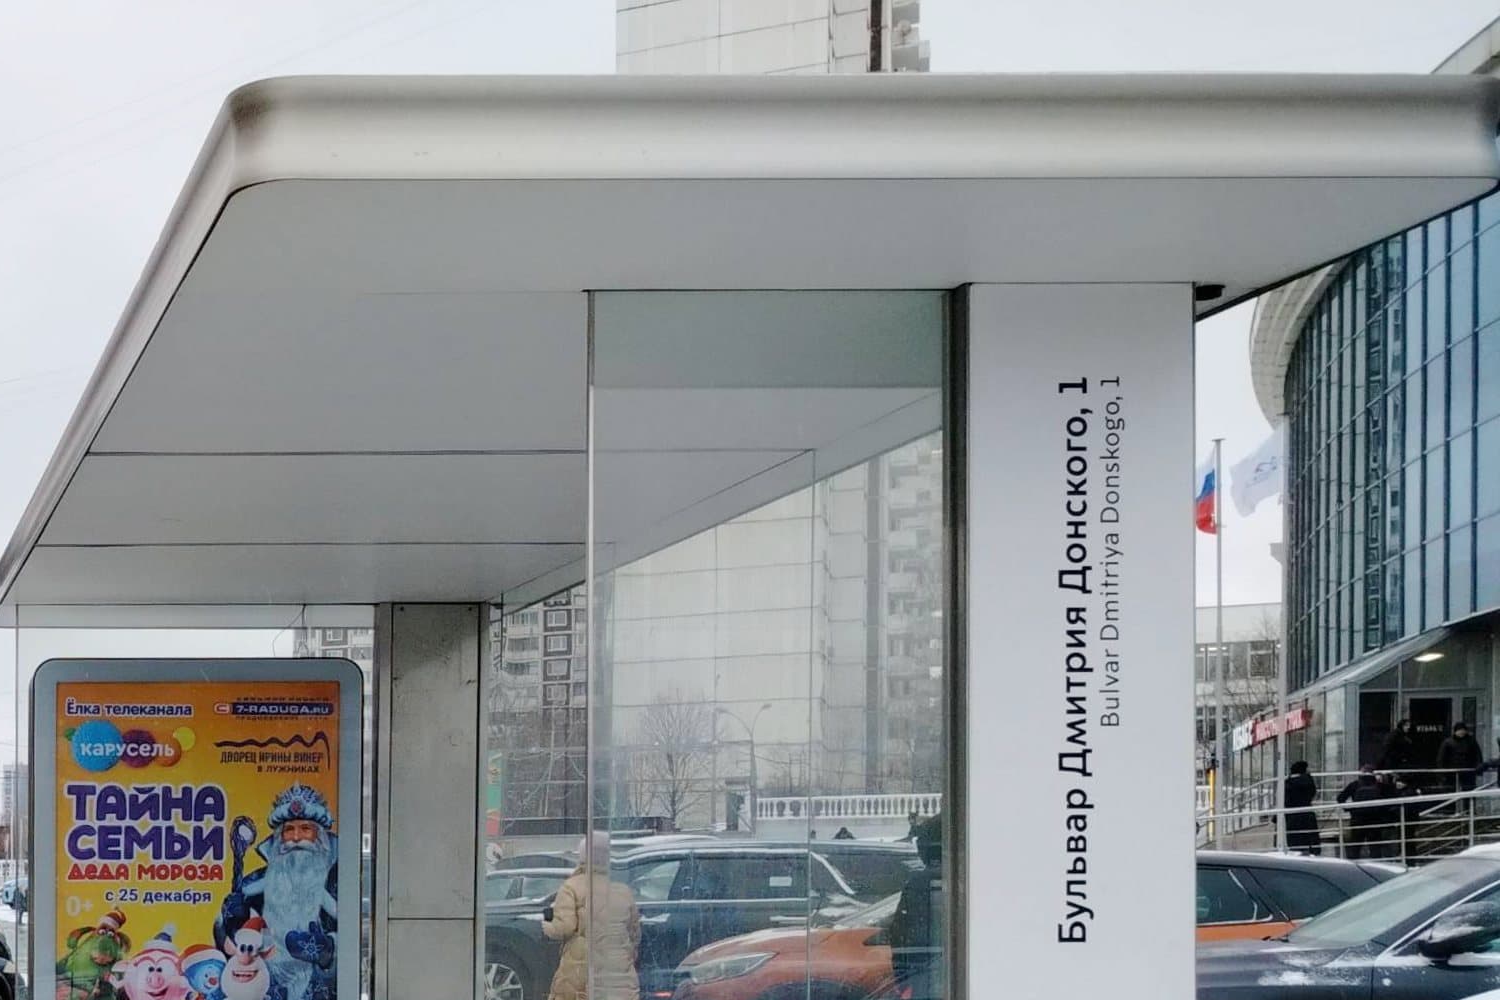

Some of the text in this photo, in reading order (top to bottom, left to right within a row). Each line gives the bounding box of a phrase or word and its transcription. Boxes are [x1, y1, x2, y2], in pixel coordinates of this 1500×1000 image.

[1099, 375, 1125, 728] Bulvar Dmitriya Donskogo, 1
[1057, 376, 1095, 944] Бульвар Дмитрия Донского, 1
[66, 698, 192, 716] Ёлка телеканала
[219, 751, 257, 764] ДВОРЕЦ
[266, 765, 320, 773] ЛУЖНИКАХ
[66, 784, 225, 822] ТАЙНА
[67, 824, 225, 861] СЕМЬИ
[137, 863, 224, 881] МОРОЗА
[119, 888, 138, 902] 25
[142, 888, 212, 905] декабря
